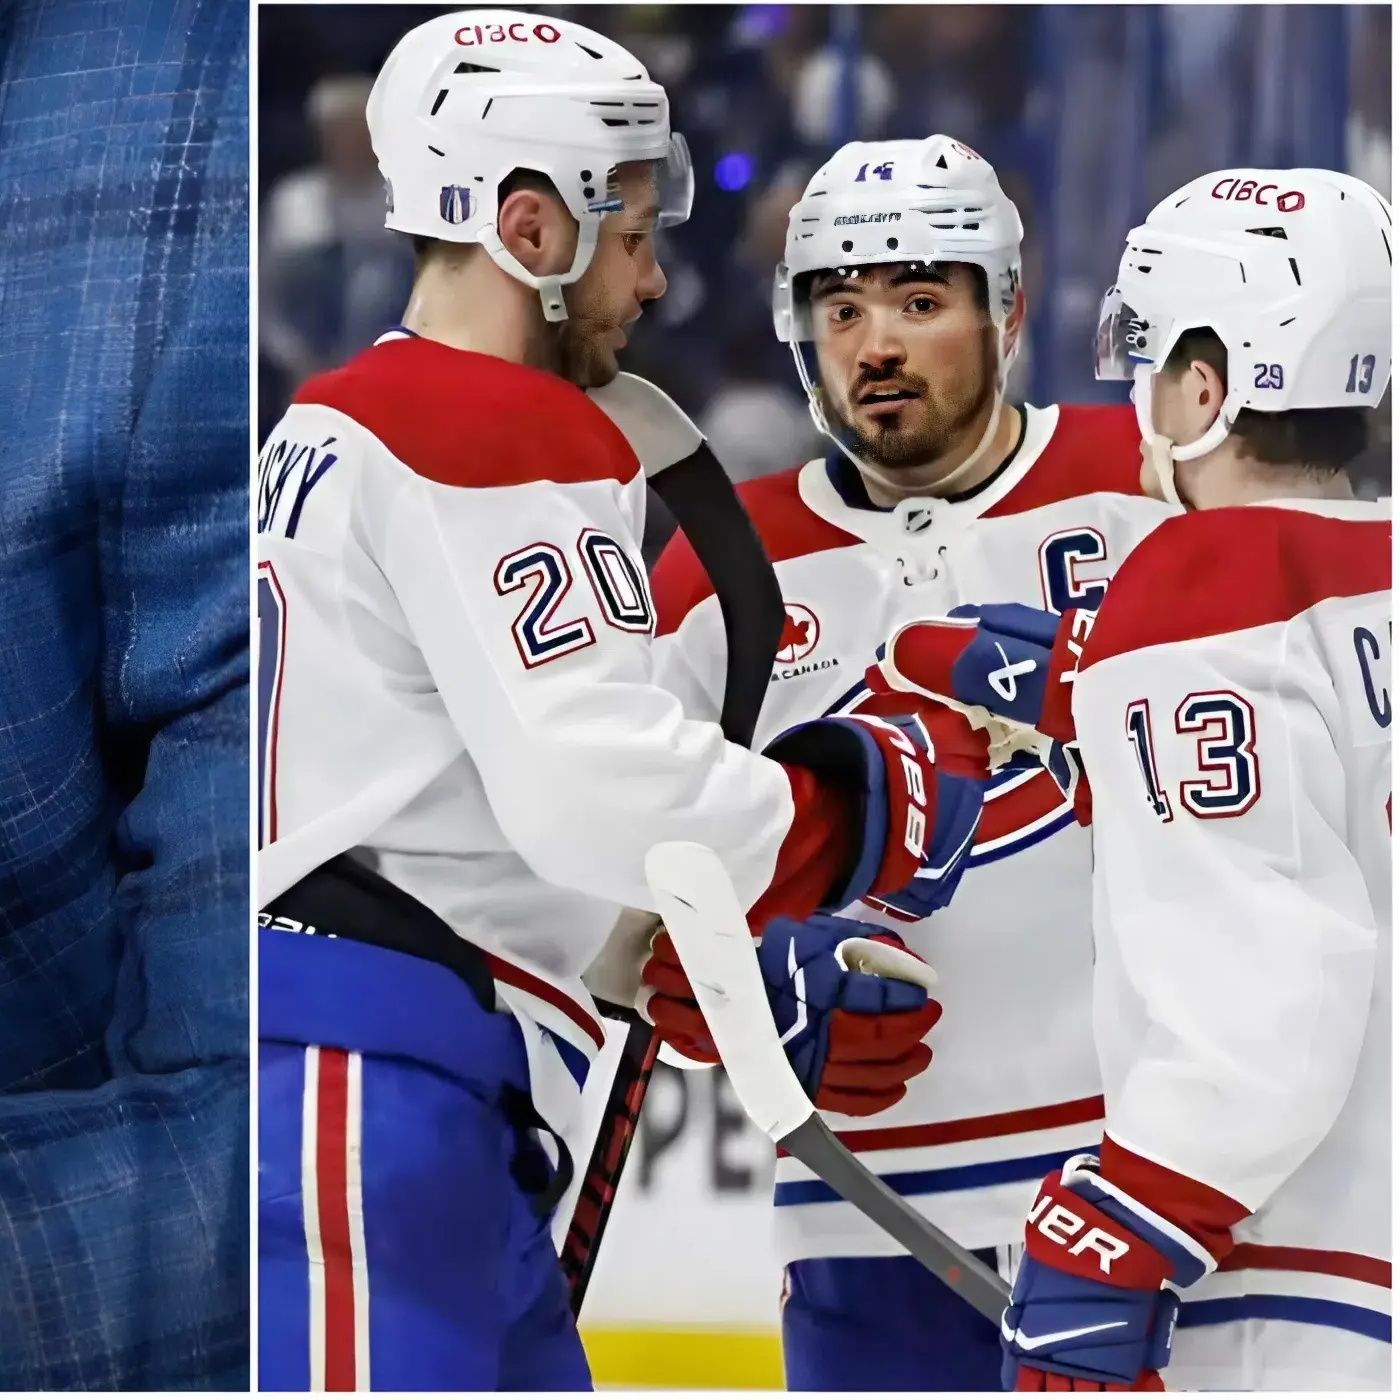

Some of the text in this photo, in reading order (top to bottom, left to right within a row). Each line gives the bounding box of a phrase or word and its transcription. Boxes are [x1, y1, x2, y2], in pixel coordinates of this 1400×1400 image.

[493, 527, 657, 669] 20
[1038, 526, 1111, 616] C
[1126, 690, 1261, 823] 13
